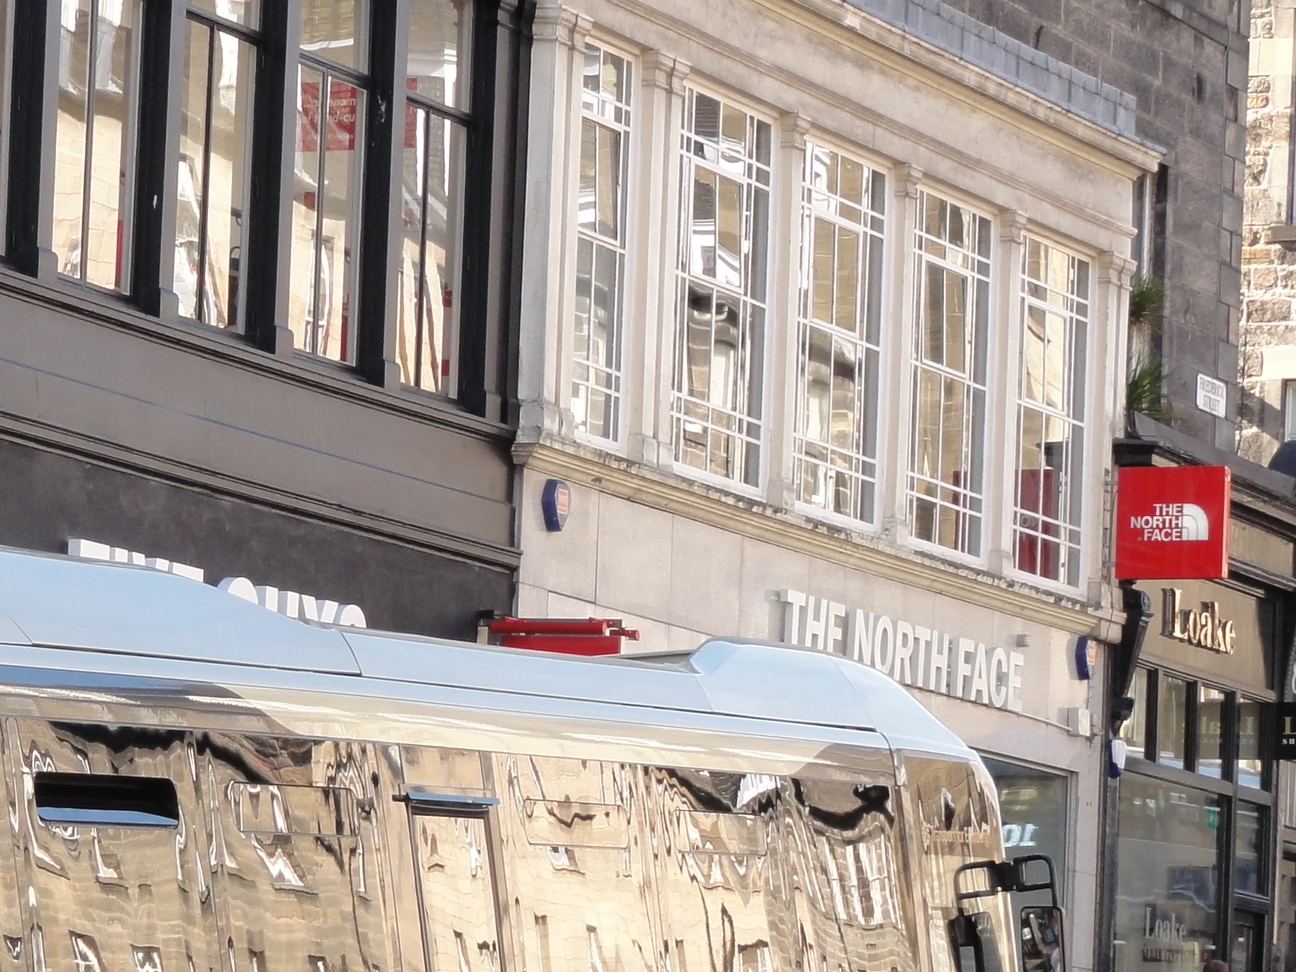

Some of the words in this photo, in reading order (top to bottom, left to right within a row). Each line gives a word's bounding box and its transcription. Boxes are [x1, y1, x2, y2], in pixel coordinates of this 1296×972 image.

[1153, 503, 1182, 515] THE
[1130, 516, 1182, 529] NORTH
[1143, 528, 1182, 541] FACE
[1168, 587, 1236, 654] Loake
[784, 589, 846, 653] THE
[851, 608, 949, 694] NORTH
[956, 638, 1025, 713] FACE
[1144, 906, 1187, 943] Loake
